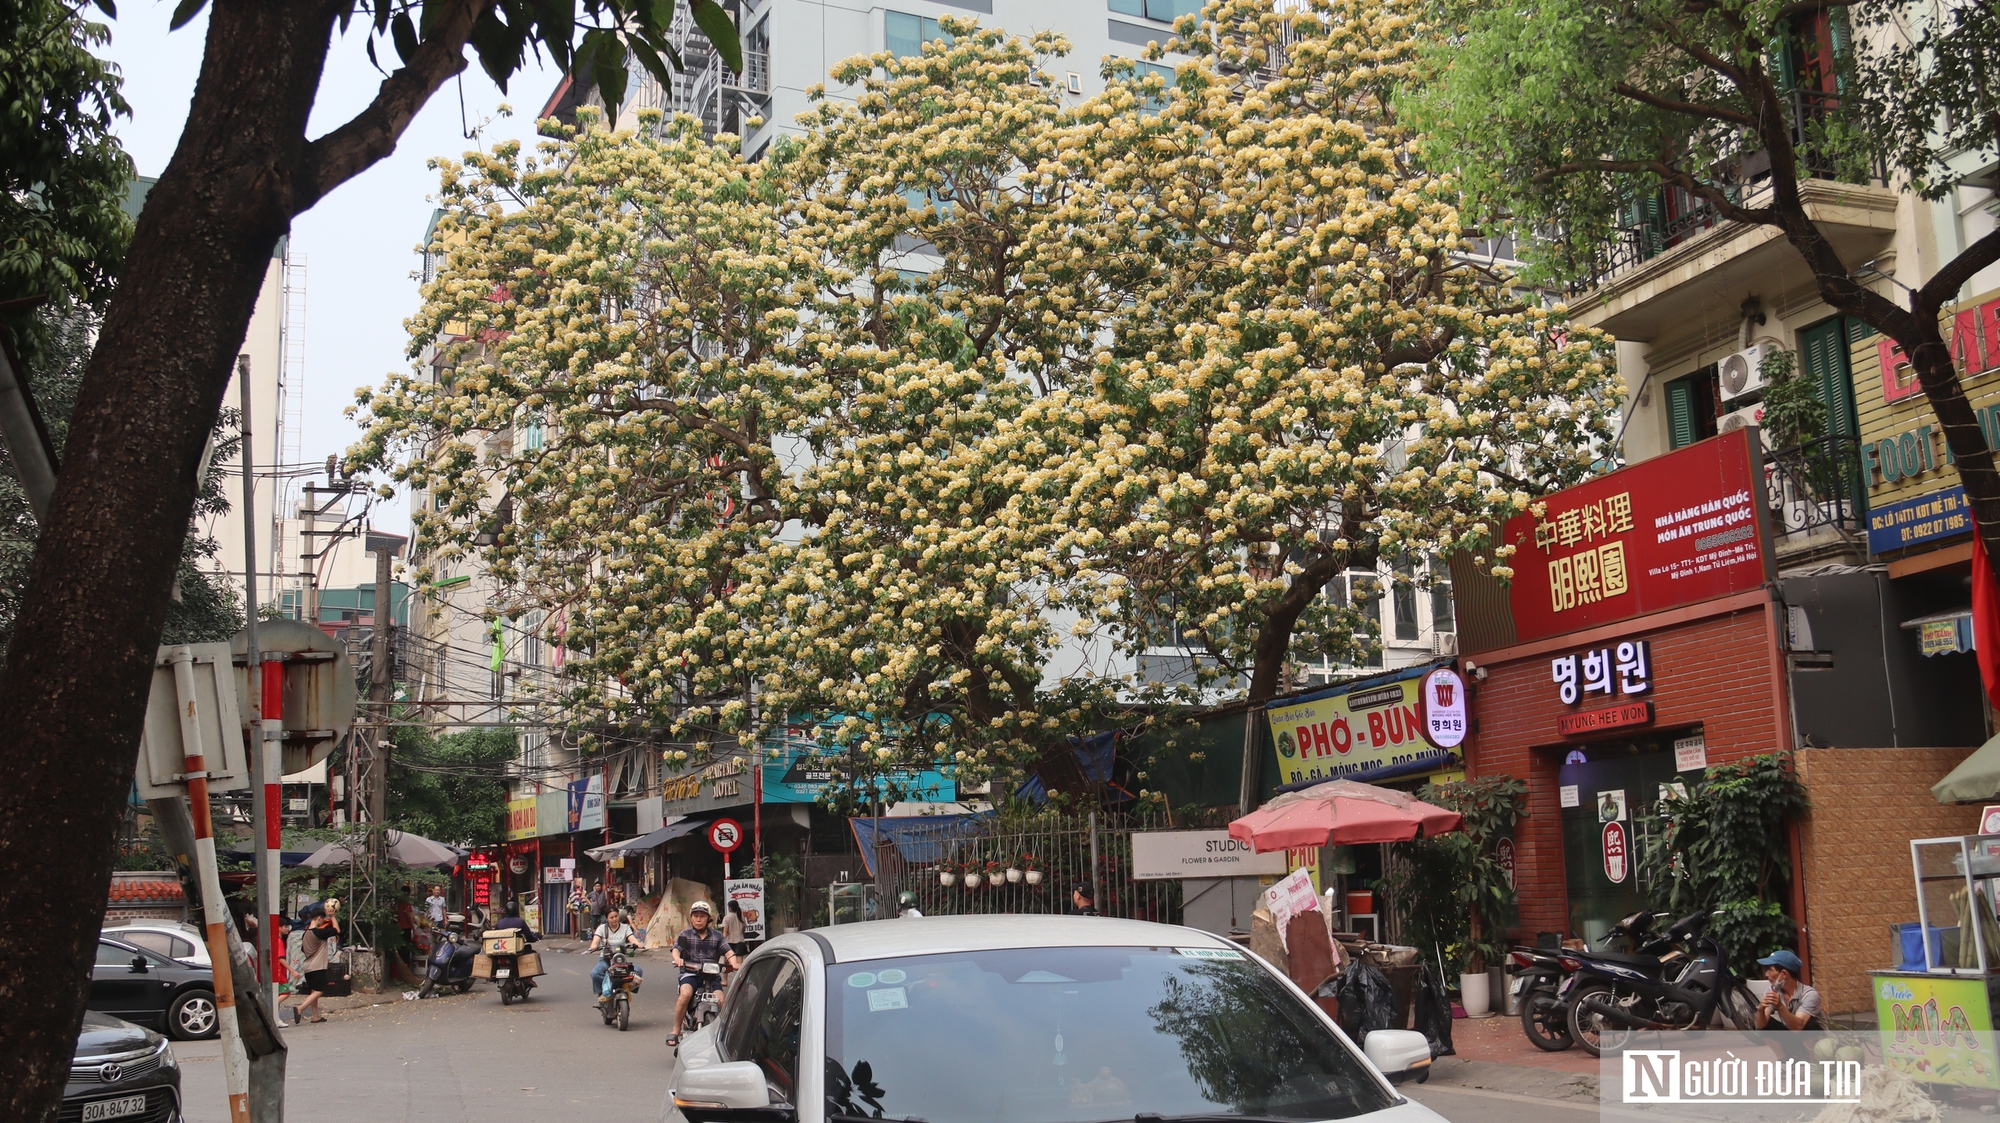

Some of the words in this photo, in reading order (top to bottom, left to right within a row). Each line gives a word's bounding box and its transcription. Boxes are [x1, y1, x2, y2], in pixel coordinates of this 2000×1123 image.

[1861, 424, 1934, 488] FOOT
[1655, 512, 1674, 528] NHÀ
[1675, 505, 1700, 522] HÀNG
[1701, 499, 1721, 515] HÀN
[1722, 489, 1749, 509] QUỐC
[1944, 493, 1957, 511] TRÌ
[1535, 491, 1634, 555] 中華料理
[1657, 529, 1677, 543] MÓN
[1692, 516, 1723, 533] TRUNG
[1725, 506, 1751, 526] QUỐC
[1695, 525, 1754, 552] 0855668282
[1914, 522, 1933, 539] 0922
[1934, 520, 1943, 534] 07
[1945, 514, 1964, 530] 1985
[1548, 540, 1628, 613] 明熙園
[1648, 568, 1661, 576] Villa
[1552, 641, 1647, 705] 명희원
[1296, 711, 1352, 759] PHỞ
[1367, 702, 1422, 748] BÚN
[1432, 720, 1462, 731] 명희원
[1562, 715, 1595, 731] MYUNG
[1598, 711, 1617, 725] HEE
[1620, 707, 1645, 721] WON
[1892, 998, 1979, 1049] MÍA
[85, 1097, 144, 1120] 30A-847.32
